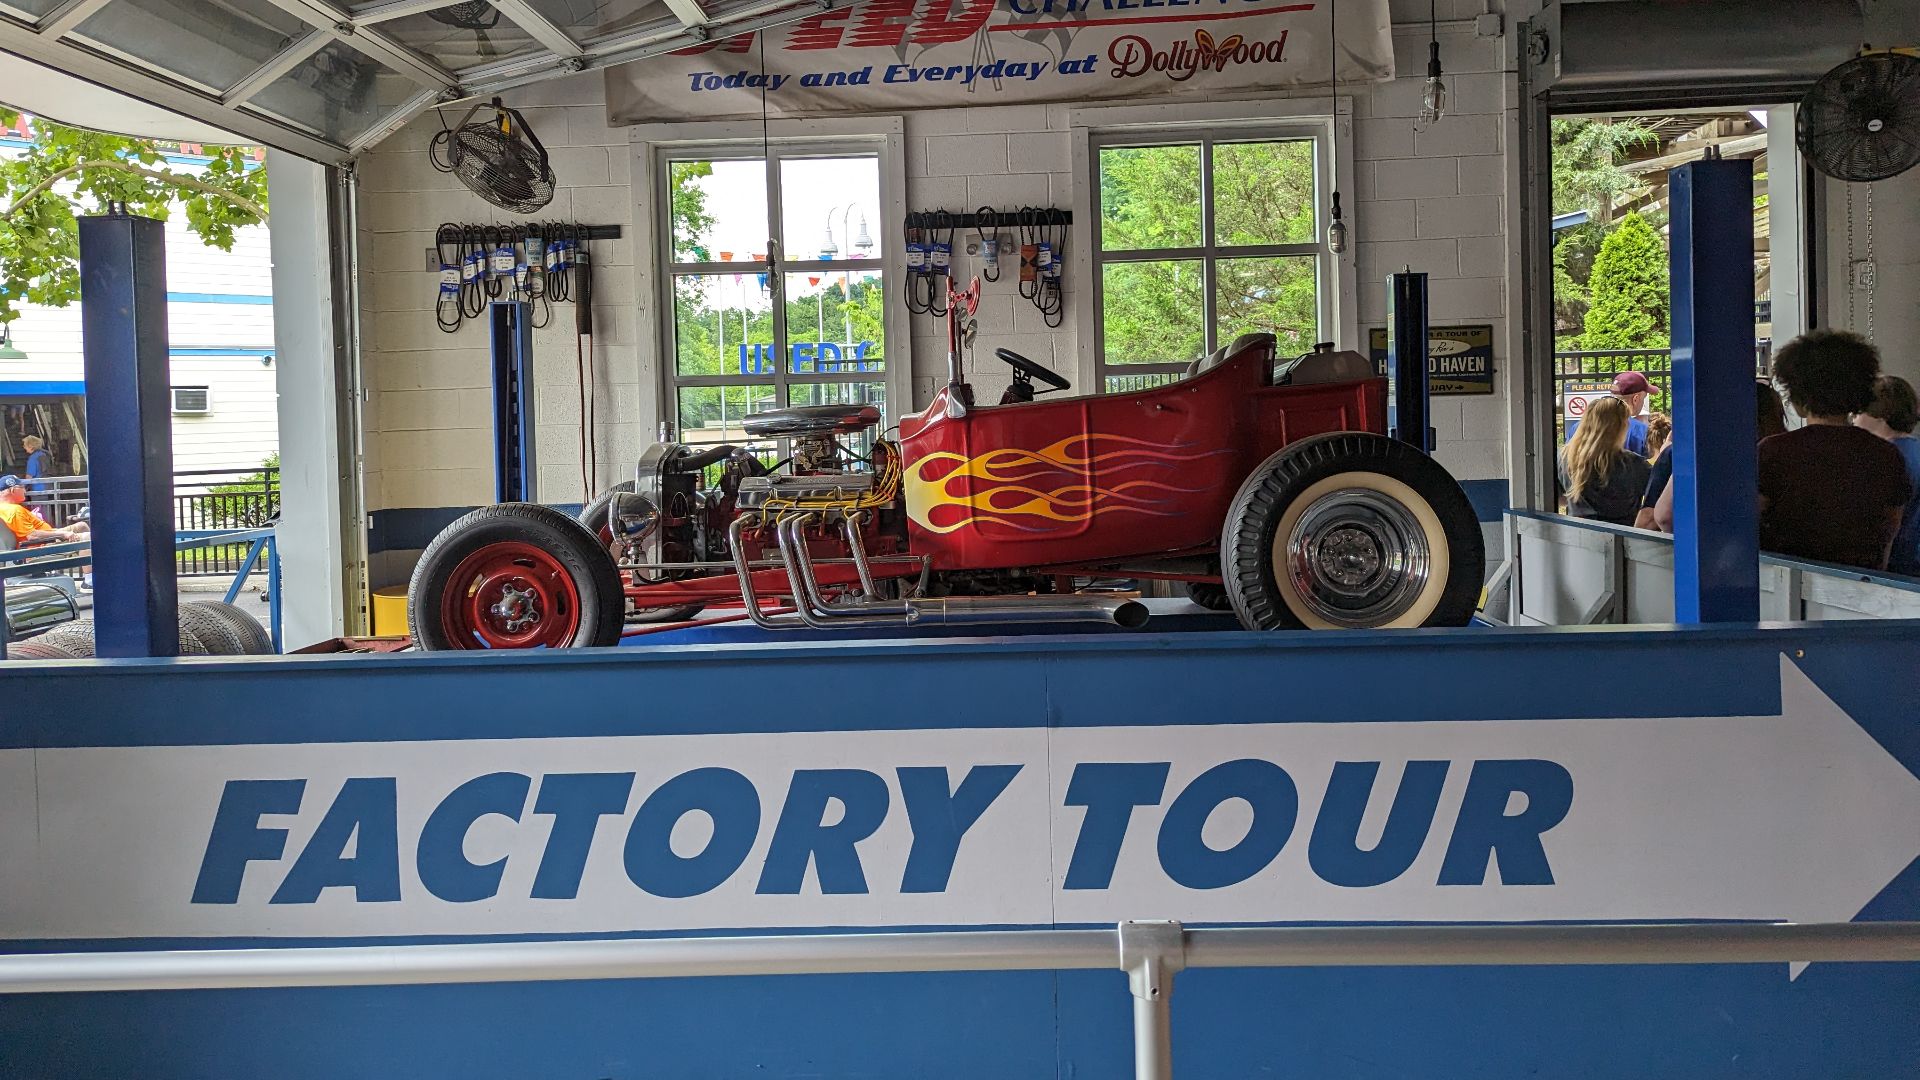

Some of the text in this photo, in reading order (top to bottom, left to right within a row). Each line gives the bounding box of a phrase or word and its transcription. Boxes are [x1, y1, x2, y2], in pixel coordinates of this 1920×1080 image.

[687, 71, 791, 92] Today
[800, 66, 873, 87] and
[883, 59, 1048, 85] Everyday
[1058, 54, 1099, 74] at
[1441, 356, 1485, 372] HAVEN
[190, 758, 1574, 904] FACTORY TOUR
